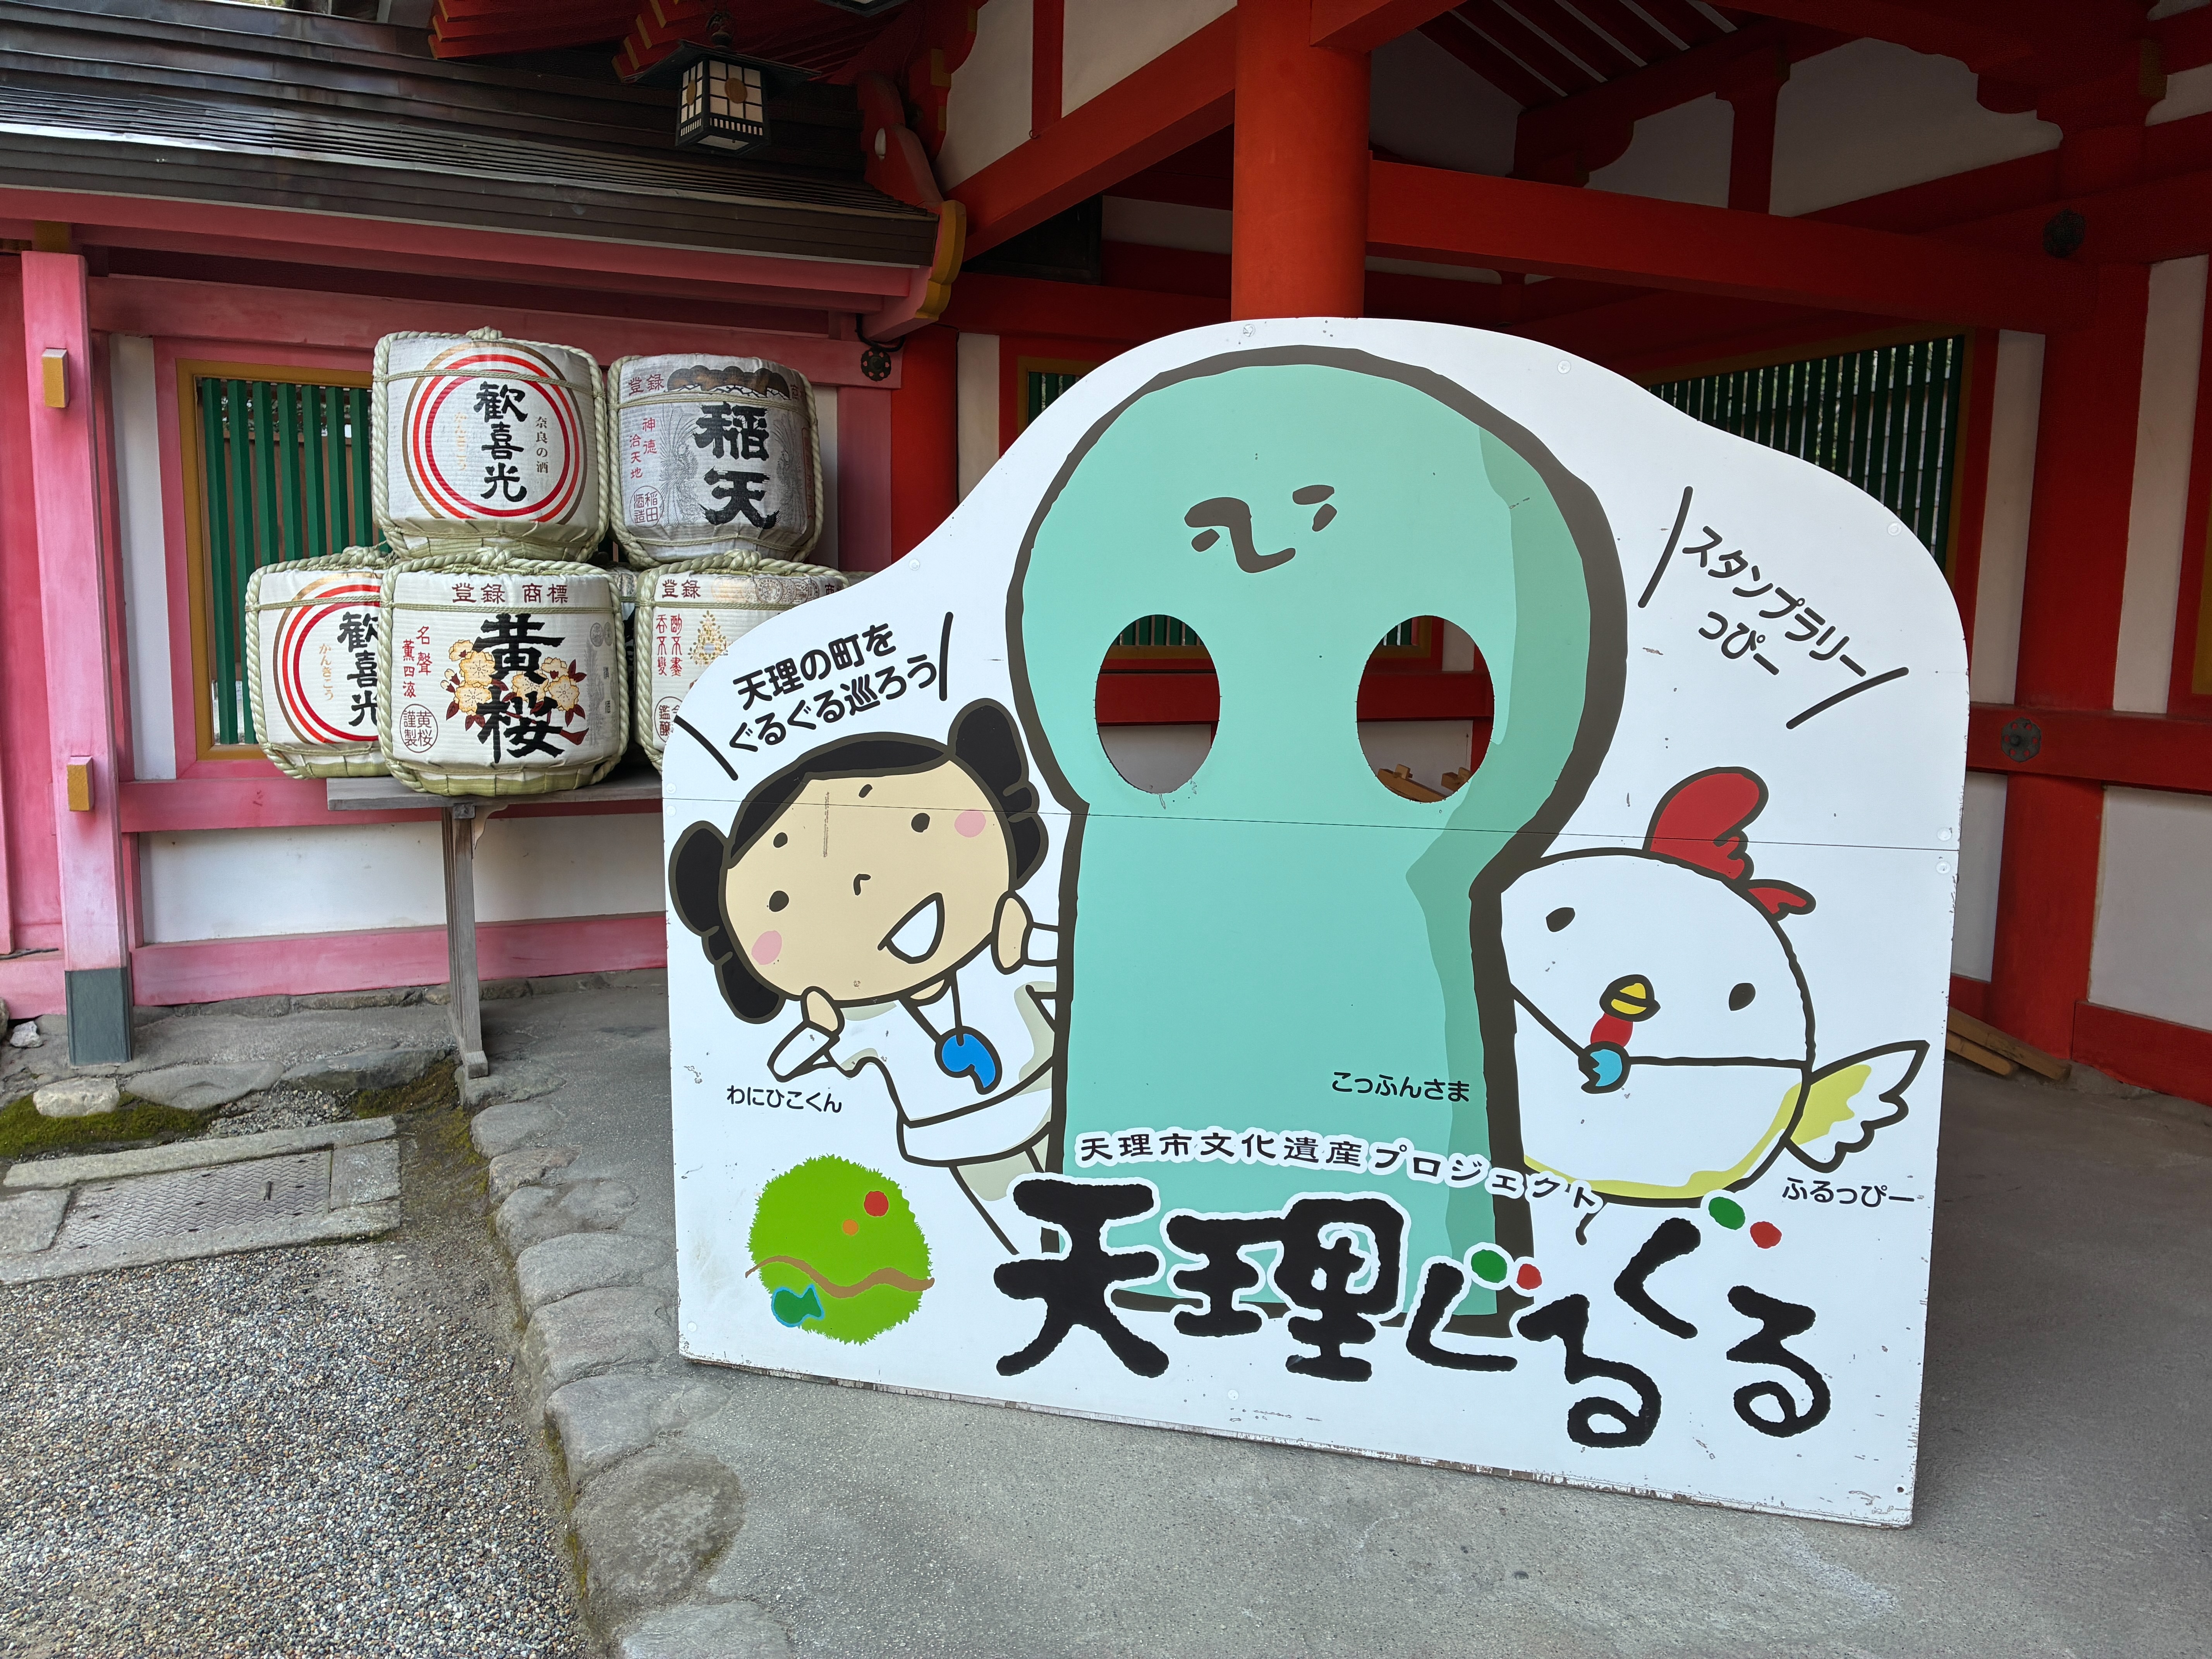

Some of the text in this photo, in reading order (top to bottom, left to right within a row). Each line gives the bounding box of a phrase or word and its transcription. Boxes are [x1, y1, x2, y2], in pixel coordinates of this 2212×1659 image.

[629, 373, 665, 396] 登録
[473, 381, 528, 502] 歓喜光
[535, 416, 549, 474] 奈良の酒
[694, 401, 781, 529] 稲天
[452, 582, 569, 604] 登録 商標
[662, 579, 701, 599] 登録
[1682, 526, 1867, 677] スタンプラリー
[319, 643, 334, 701] かんきこう
[472, 613, 567, 764] 黄桜
[733, 623, 896, 711] 天理の町を
[729, 654, 937, 752] ぐるぐる巡ろう
[727, 1085, 842, 1113] わにひこくん
[1332, 1072, 1470, 1102] こっふんさま
[1081, 1132, 1596, 1208] 天理市文化遺産プロジェクト
[1782, 1177, 1915, 1207] ふるっぴー
